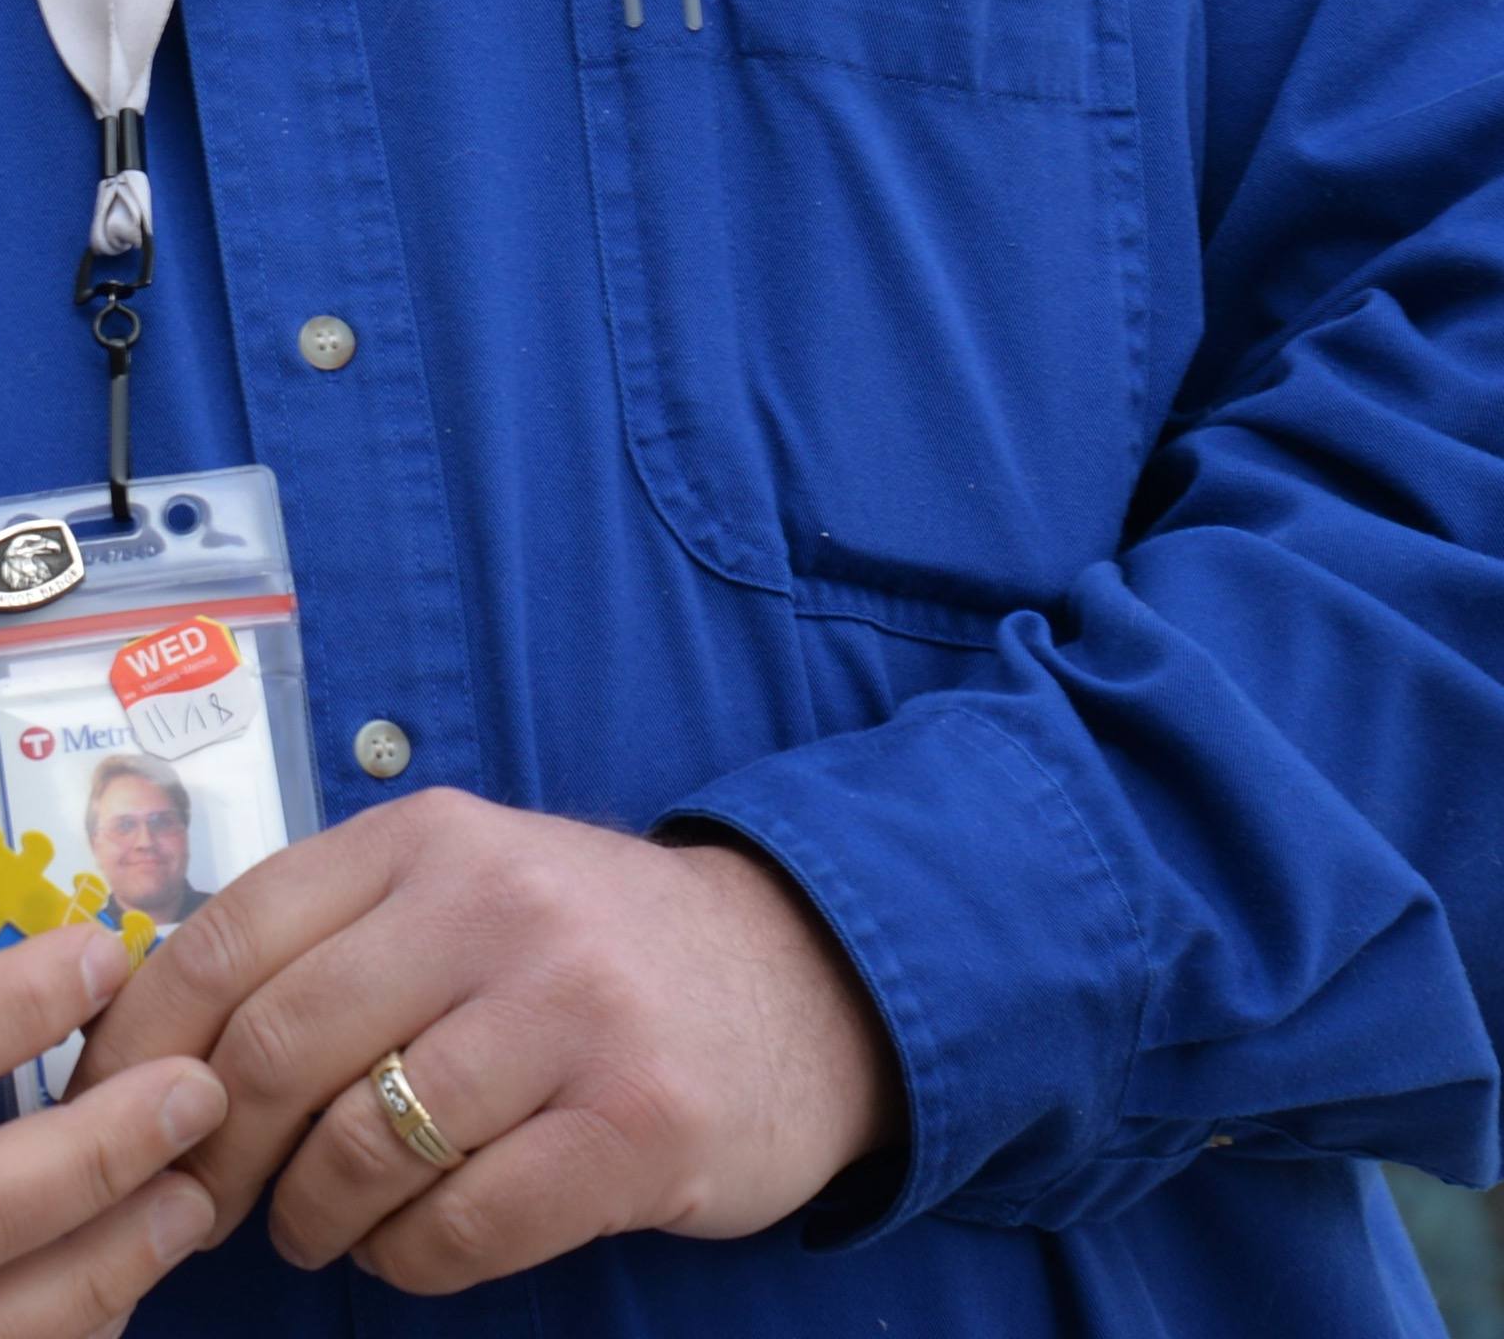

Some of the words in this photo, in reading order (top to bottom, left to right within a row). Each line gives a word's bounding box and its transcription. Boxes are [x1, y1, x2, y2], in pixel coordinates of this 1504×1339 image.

[125, 626, 208, 678] WED
[22, 731, 51, 757] T
[61, 724, 133, 754] Metr
[144, 691, 235, 744] 11/18
